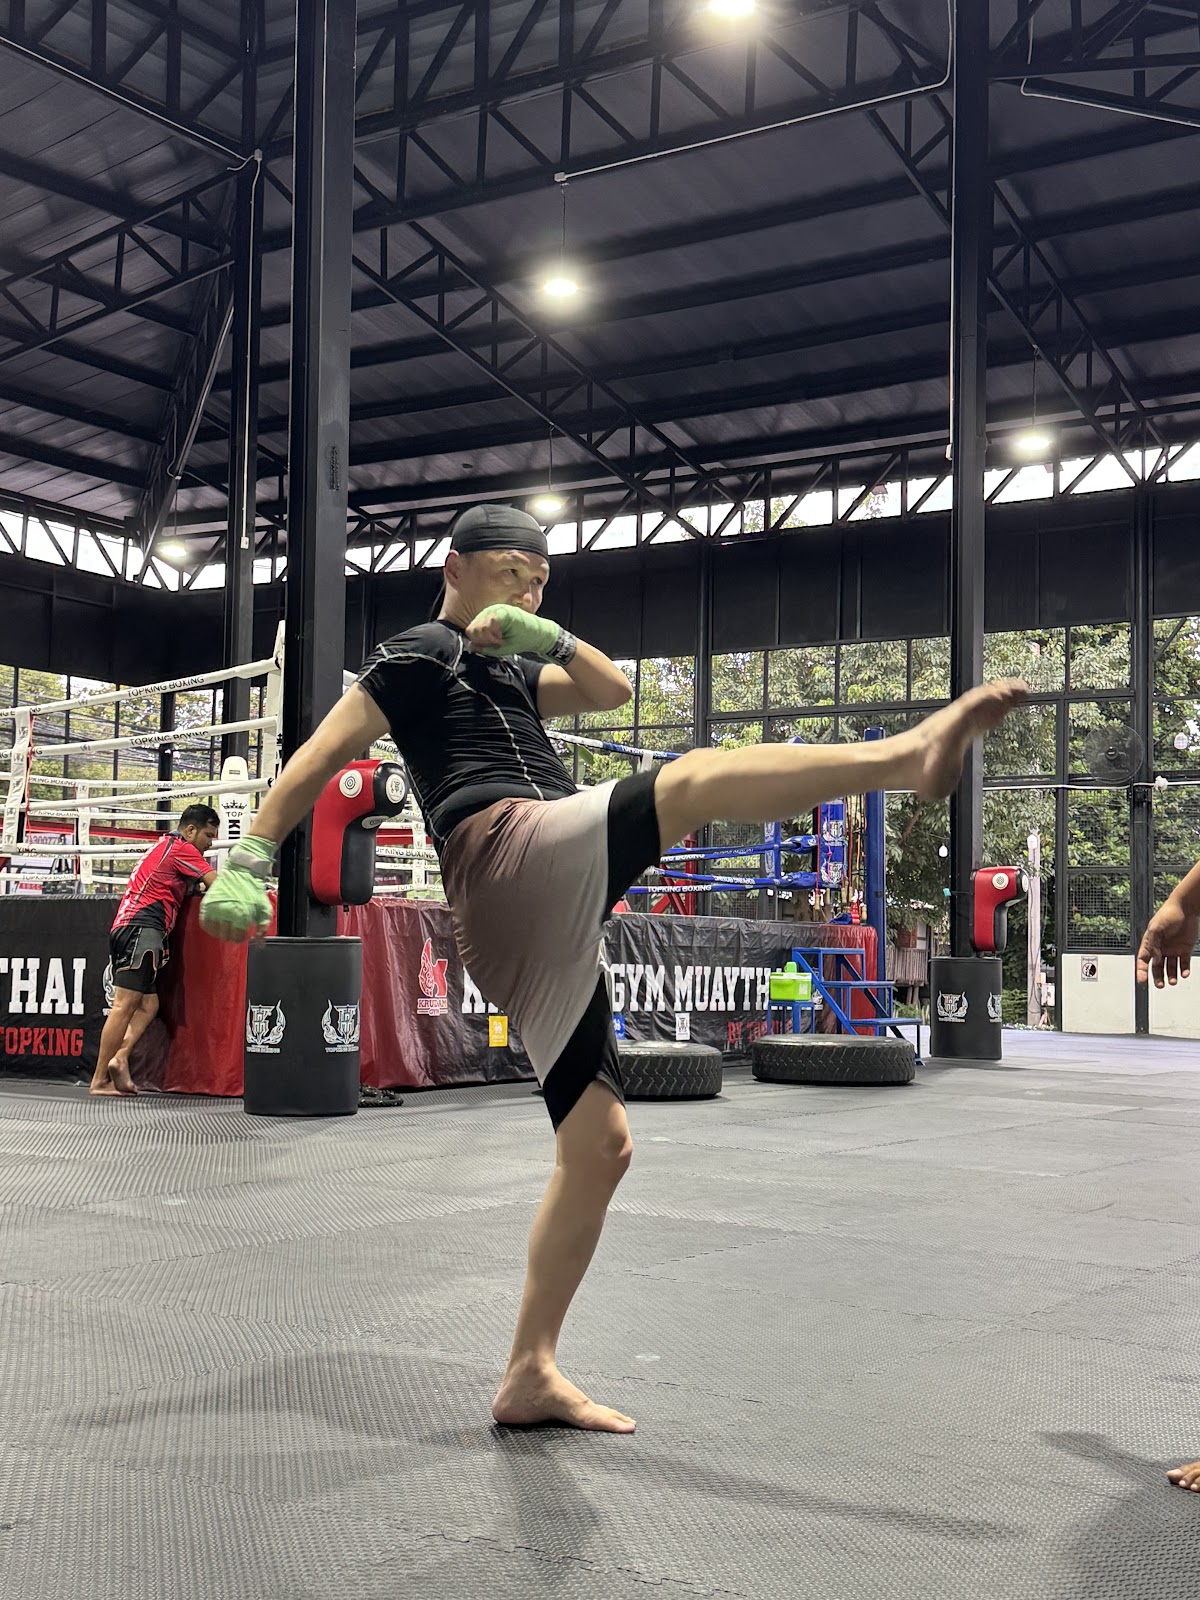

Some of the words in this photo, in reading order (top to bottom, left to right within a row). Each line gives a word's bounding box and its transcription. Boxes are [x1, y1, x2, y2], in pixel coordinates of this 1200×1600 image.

[127, 684, 168, 698] TOPKING
[168, 676, 205, 690] BOXING
[610, 963, 666, 1012] GYM
[673, 965, 793, 1012] MUAYTH
[417, 999, 448, 1009] KRUDAM
[728, 1021, 743, 1044] BY
